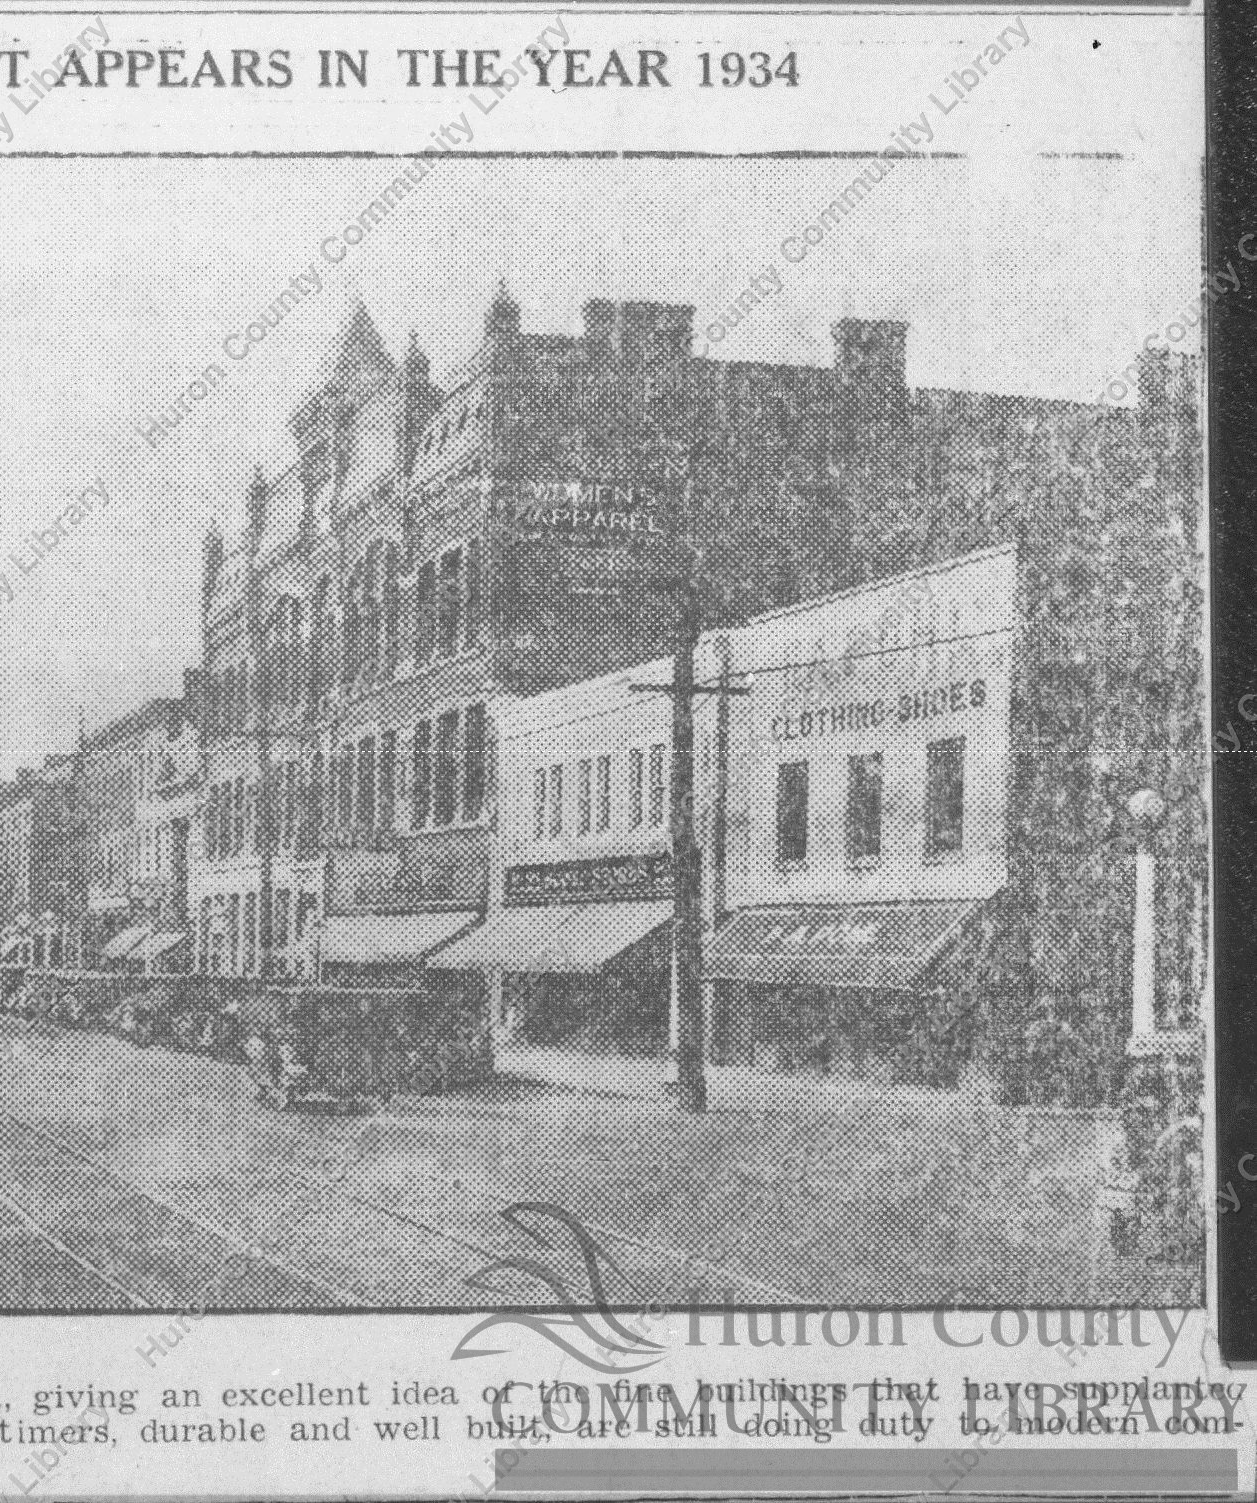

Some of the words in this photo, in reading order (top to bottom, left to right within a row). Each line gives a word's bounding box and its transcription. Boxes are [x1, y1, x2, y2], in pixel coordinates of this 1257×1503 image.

[55, 49, 292, 88] APPEARS
[319, 50, 367, 87] IN
[397, 49, 503, 87] THE
[524, 49, 671, 87] YEAR
[699, 51, 801, 88] 1934
[33, 1384, 139, 1413] giving
[162, 1390, 202, 1407] an
[222, 1382, 370, 1406] excellent
[391, 1381, 459, 1405] idea
[481, 1379, 515, 1405] of
[539, 1378, 592, 1404] the
[613, 1376, 673, 1404] fine
[696, 1377, 847, 1410] buildings
[871, 1377, 939, 1402] that
[963, 1376, 1041, 1403] have
[140, 1418, 266, 1443] durable
[290, 1417, 351, 1441] and
[374, 1415, 440, 1440] well
[467, 1415, 552, 1441] built,
[576, 1418, 632, 1439] are
[653, 1413, 718, 1439] still
[743, 1413, 834, 1443] doing
[857, 1412, 935, 1442] duty
[958, 1413, 993, 1437] to
[1015, 1411, 1140, 1437] modern
[1163, 1415, 1245, 1436] com-
